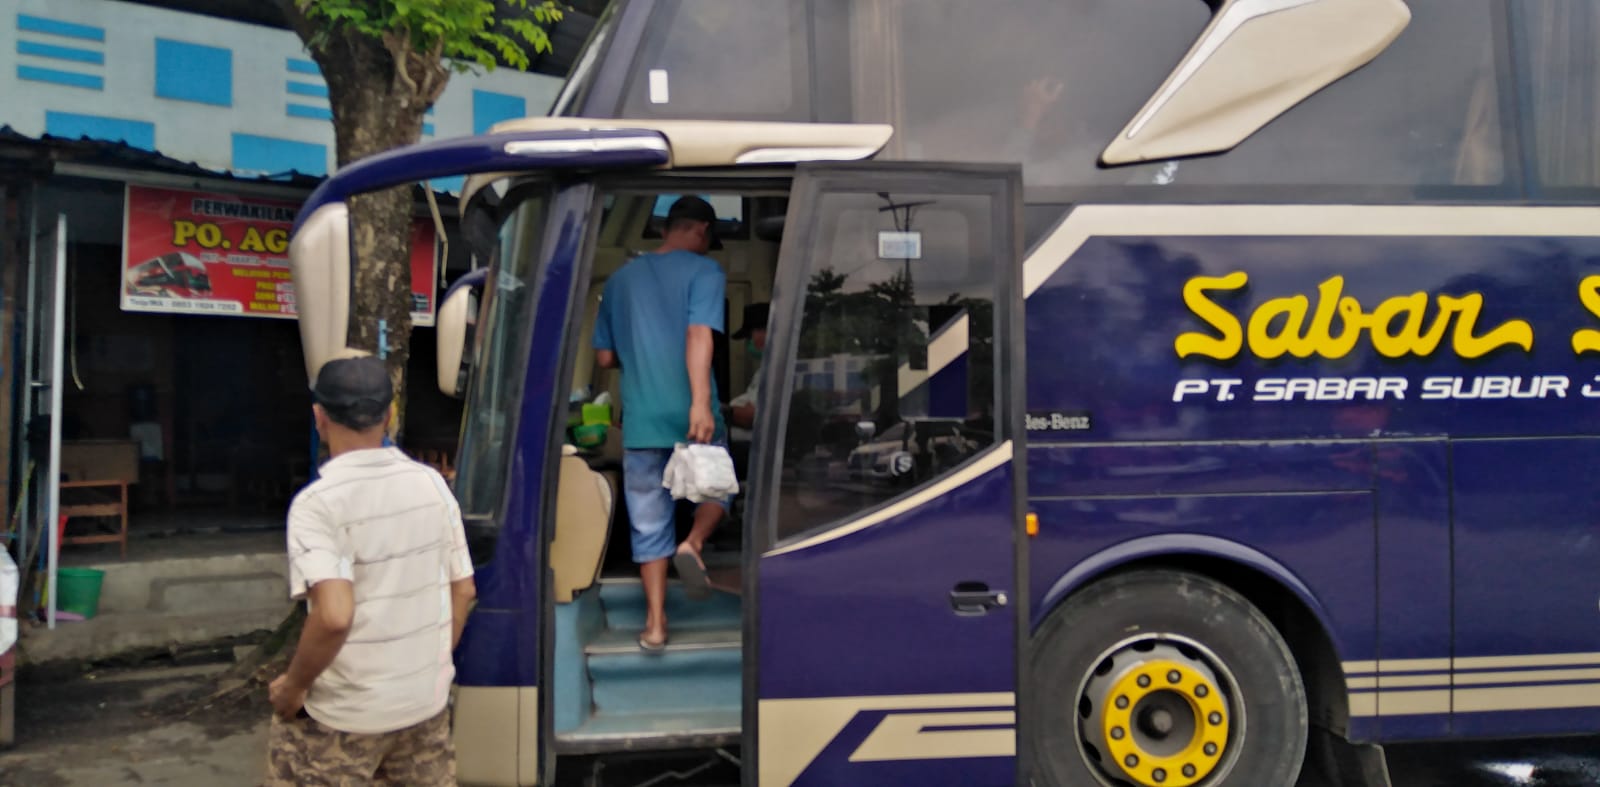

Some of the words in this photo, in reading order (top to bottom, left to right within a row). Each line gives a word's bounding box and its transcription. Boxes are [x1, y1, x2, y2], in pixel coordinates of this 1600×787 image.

[191, 198, 294, 223] PERWAKILAN
[173, 220, 231, 249] PO.
[239, 227, 289, 252] AG
[1174, 271, 1534, 361] Sabar
[1172, 378, 1243, 402] PT.
[1253, 376, 1409, 401] SABAR
[1420, 375, 1570, 400] SUBUR
